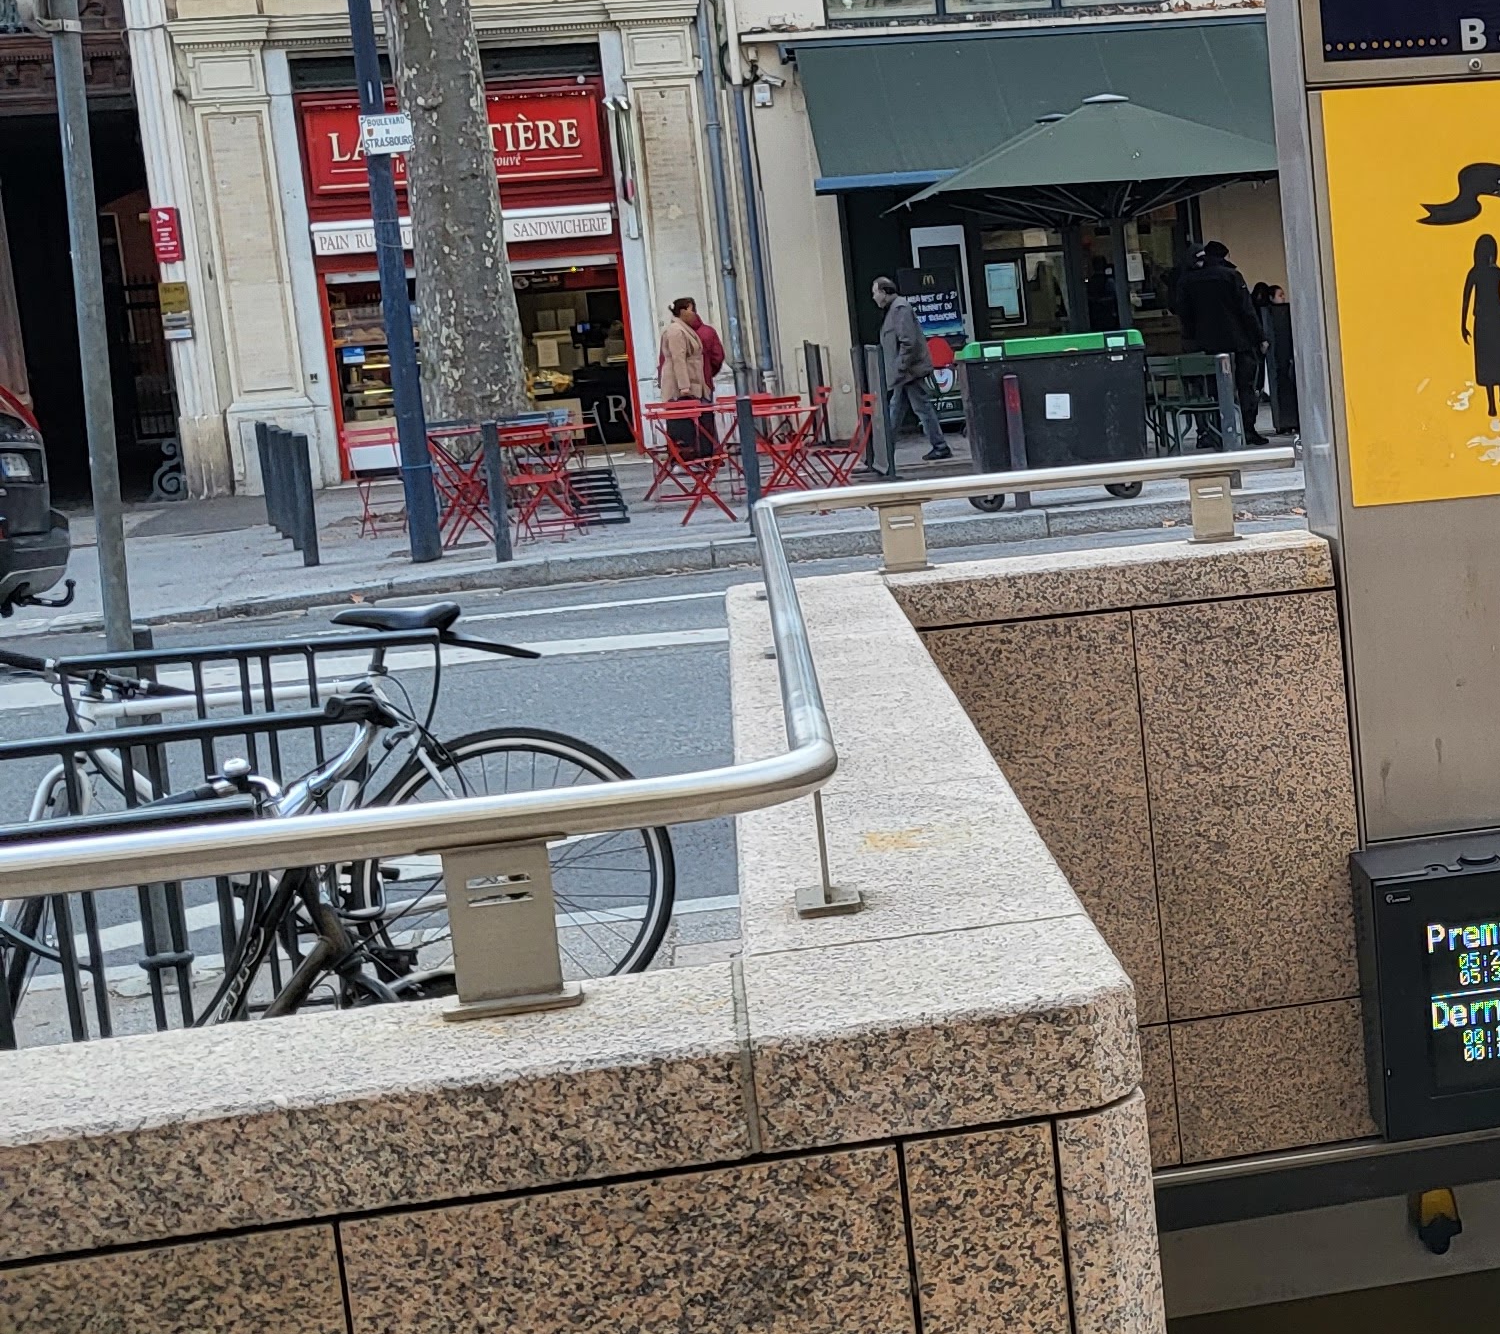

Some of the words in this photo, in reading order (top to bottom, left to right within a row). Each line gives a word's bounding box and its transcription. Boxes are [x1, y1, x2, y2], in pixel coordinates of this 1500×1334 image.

[1459, 17, 1488, 52] B
[366, 116, 405, 127] BOULEVARD
[365, 135, 414, 149] STRASBOURG
[513, 217, 608, 238] SANDWICHERIE
[320, 234, 349, 251] PAIN
